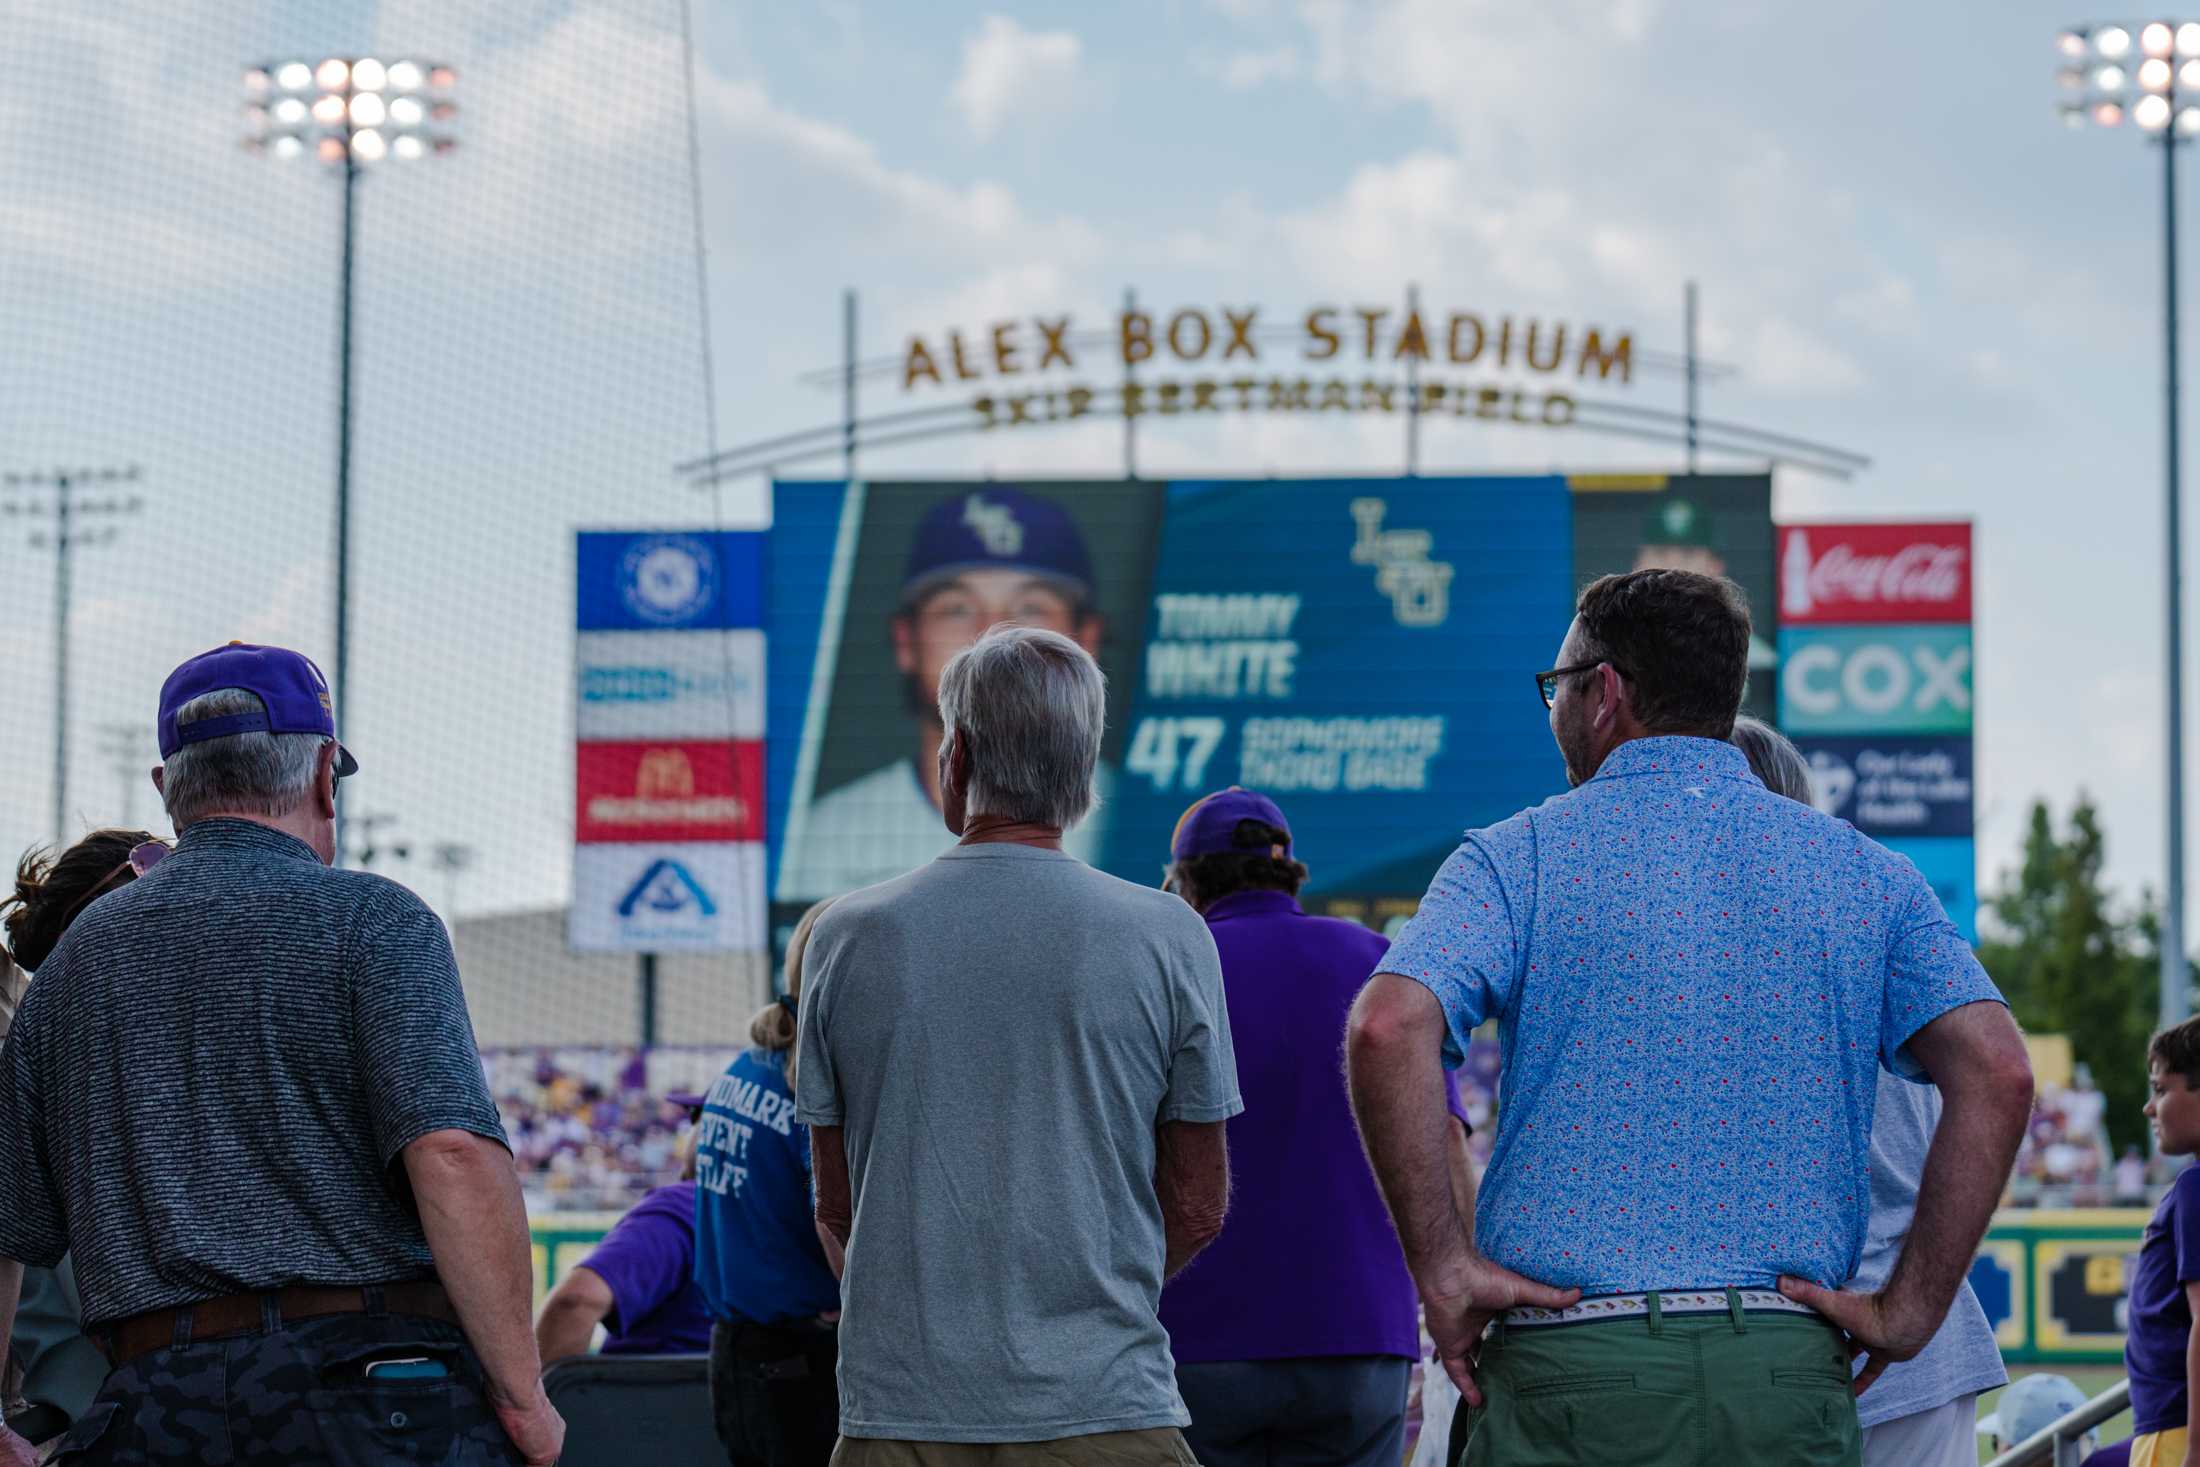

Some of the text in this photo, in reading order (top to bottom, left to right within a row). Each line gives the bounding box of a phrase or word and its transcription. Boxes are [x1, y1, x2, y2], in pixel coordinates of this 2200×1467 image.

[903, 306, 1635, 391] ALEX BOX STADIUM
[1146, 641, 1300, 698] WHITE
[1783, 643, 1971, 714] COX
[1126, 716, 1226, 791] 47
